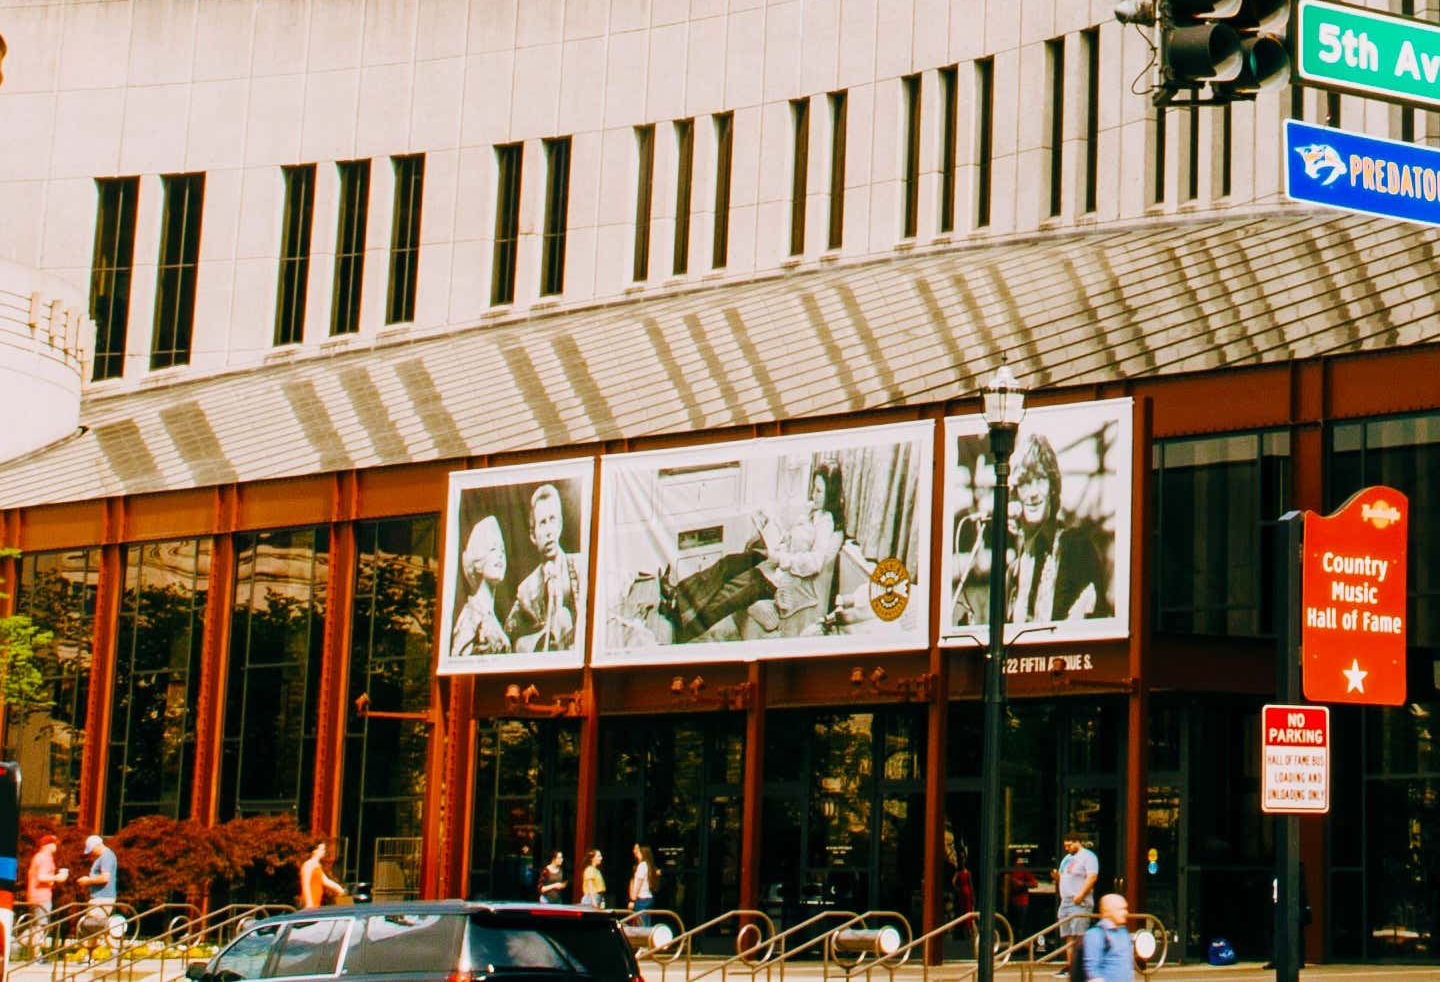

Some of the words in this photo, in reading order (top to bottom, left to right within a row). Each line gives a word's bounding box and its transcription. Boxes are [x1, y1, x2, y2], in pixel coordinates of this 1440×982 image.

[1318, 22, 1378, 72] 5th
[1322, 551, 1388, 582] Country
[1331, 581, 1378, 604] Music
[1307, 607, 1337, 629] Hall
[1342, 609, 1358, 631] of
[1363, 611, 1402, 634] Fame
[1020, 657, 1046, 672] FIFTH
[1084, 654, 1093, 669] S.
[1287, 713, 1305, 728] NO
[1269, 728, 1323, 744] PARKING
